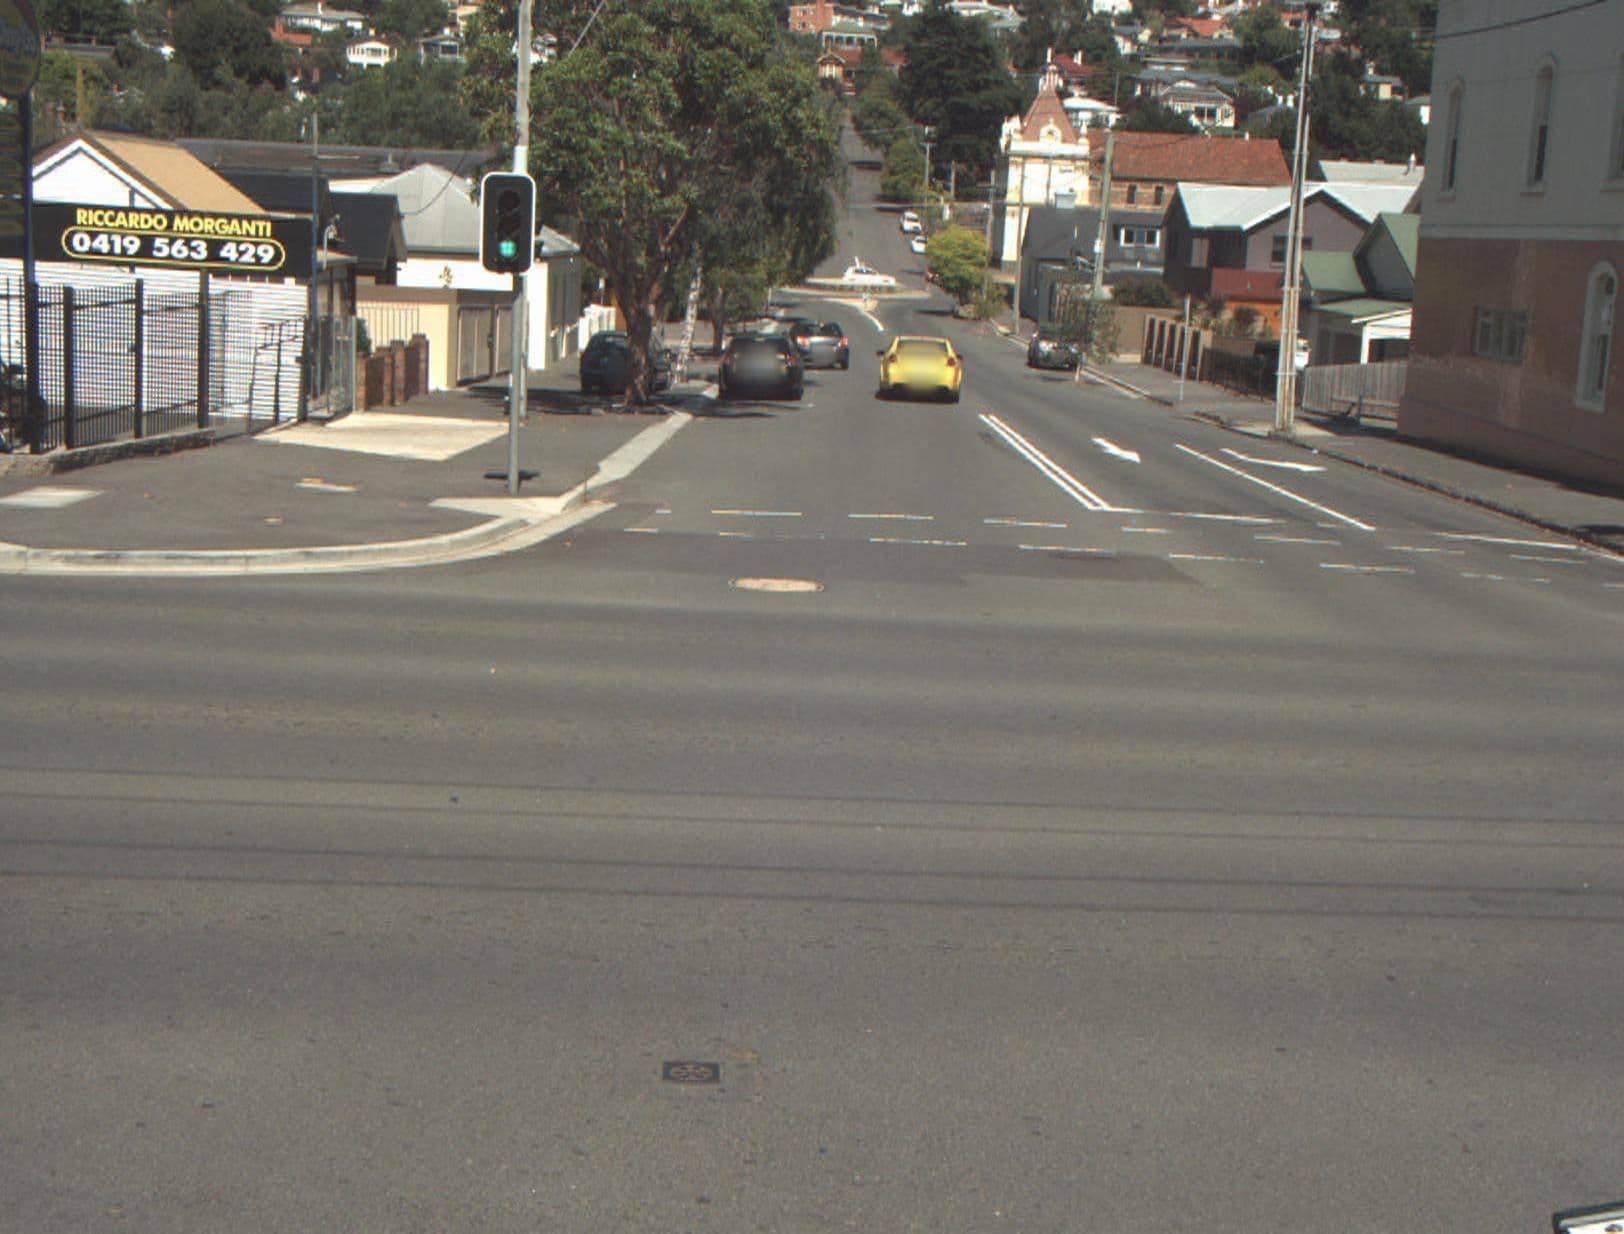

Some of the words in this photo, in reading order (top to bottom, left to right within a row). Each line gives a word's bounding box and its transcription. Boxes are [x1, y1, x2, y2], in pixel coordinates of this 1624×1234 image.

[76, 208, 168, 231] RICCARDO
[173, 215, 272, 237] MORGANTI
[72, 232, 142, 256] 0419
[152, 237, 208, 260] 563
[219, 242, 275, 264] 429
